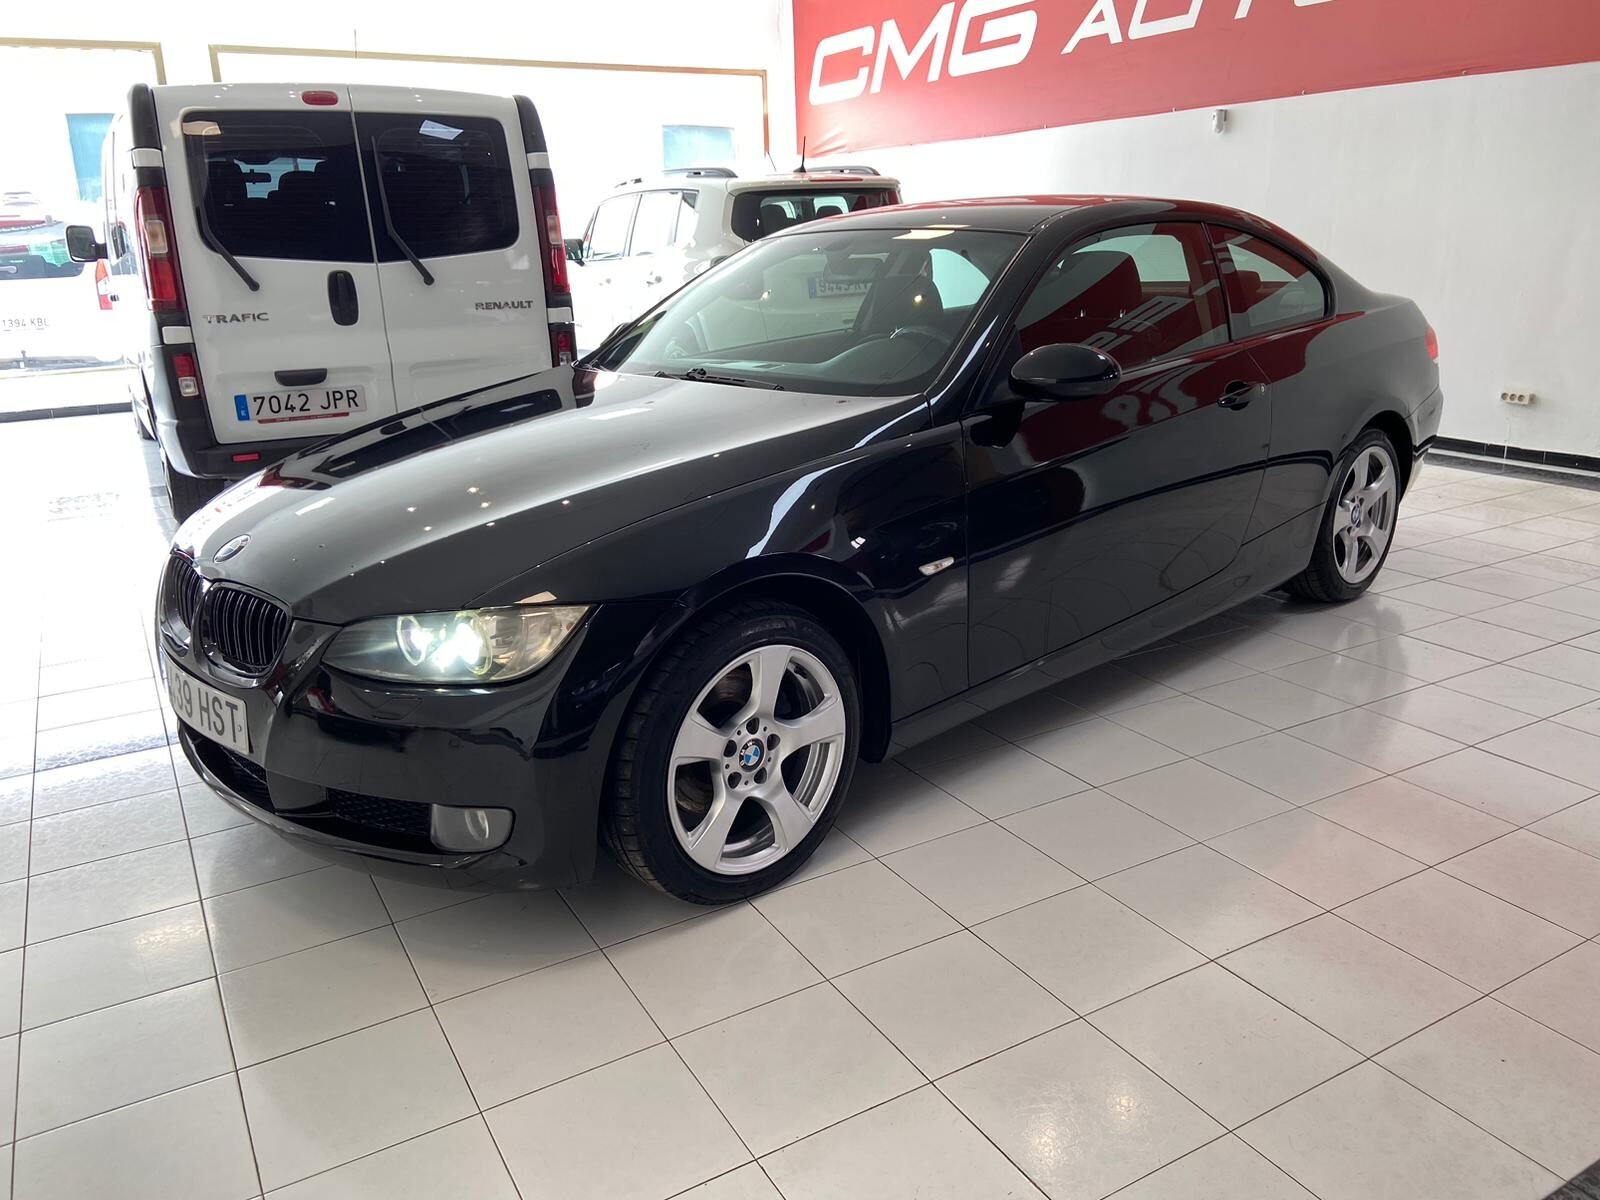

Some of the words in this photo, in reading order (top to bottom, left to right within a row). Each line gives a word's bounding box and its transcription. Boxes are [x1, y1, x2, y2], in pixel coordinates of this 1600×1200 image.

[809, 0, 1038, 106] CMG
[1060, 0, 1335, 54] AU
[475, 300, 533, 310] RENAULT
[2, 318, 26, 328] 1394
[202, 312, 269, 324] TRAFIC
[253, 393, 311, 415] 7042
[320, 389, 359, 410] JPR
[198, 687, 239, 743] HST
